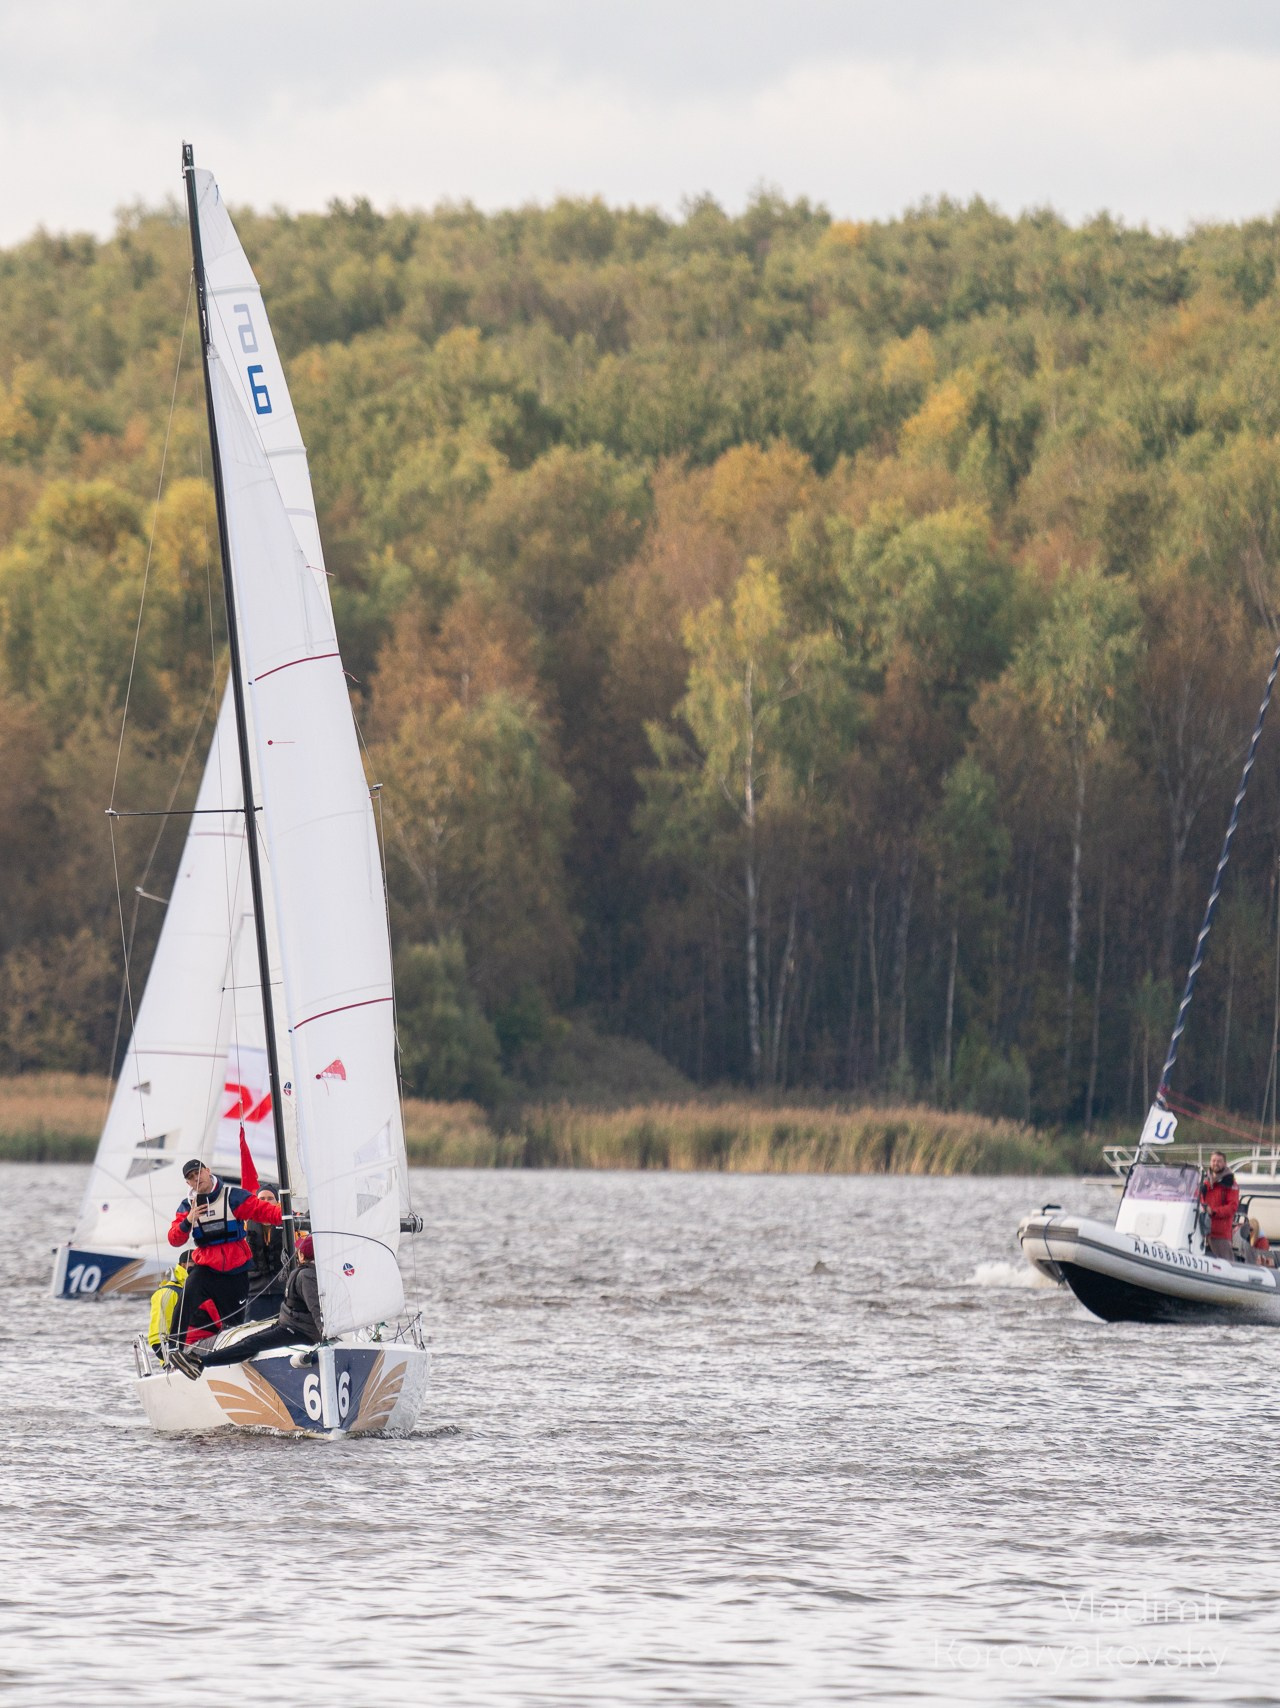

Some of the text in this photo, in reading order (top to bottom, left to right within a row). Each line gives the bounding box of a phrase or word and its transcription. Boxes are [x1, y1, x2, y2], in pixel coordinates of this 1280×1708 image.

[247, 365, 273, 415] 6
[1154, 1118, 1173, 1139] U
[68, 1263, 102, 1293] 10
[303, 1373, 322, 1421] 6
[338, 1371, 351, 1419] 6
